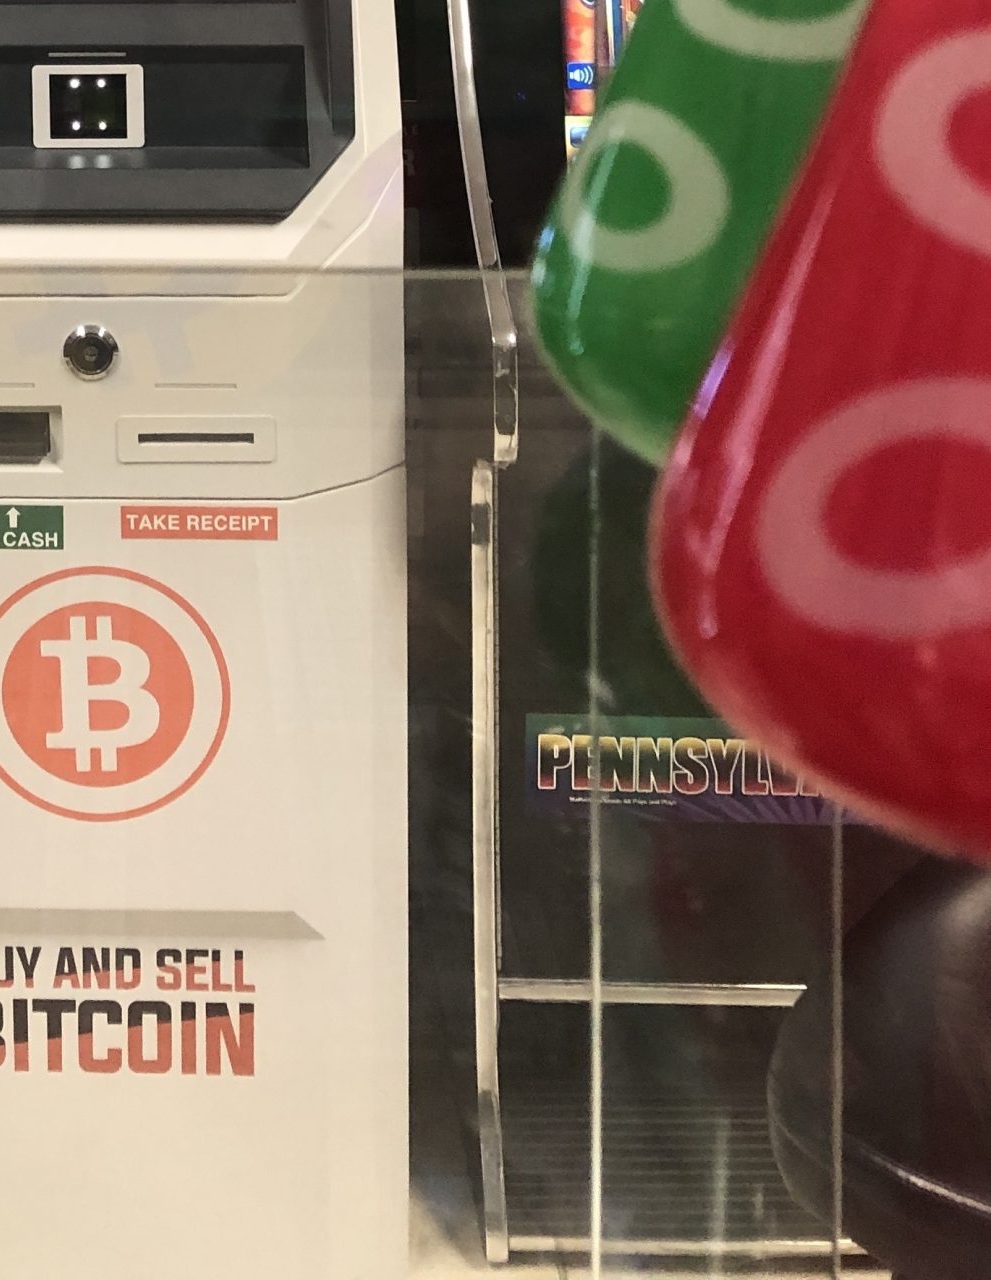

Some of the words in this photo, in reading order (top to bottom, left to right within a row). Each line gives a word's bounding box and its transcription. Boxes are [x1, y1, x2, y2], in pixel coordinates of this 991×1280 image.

[126, 514, 180, 530] TAKE
[186, 515, 273, 532] RECEIPT
[3, 531, 59, 548] CASH
[53, 947, 141, 989] AND
[156, 949, 256, 993] SELL
